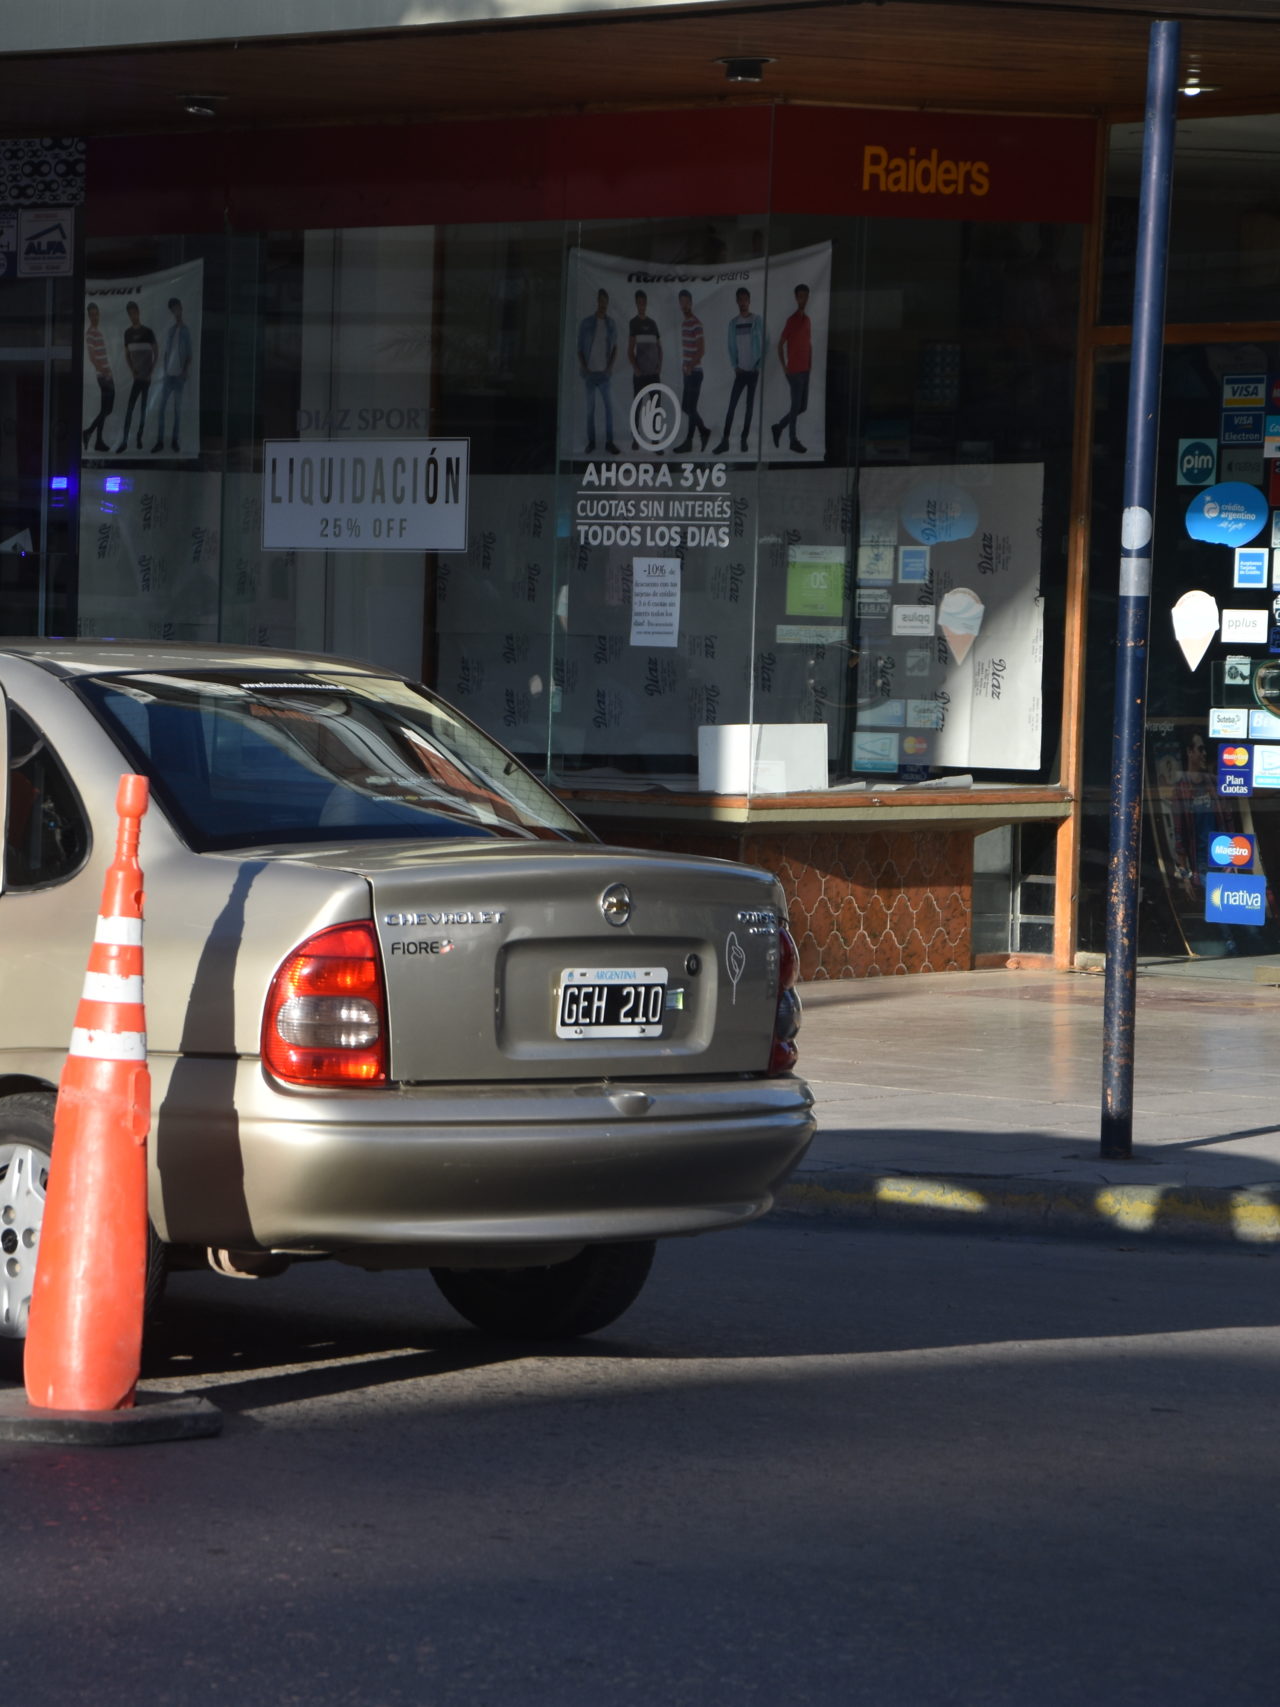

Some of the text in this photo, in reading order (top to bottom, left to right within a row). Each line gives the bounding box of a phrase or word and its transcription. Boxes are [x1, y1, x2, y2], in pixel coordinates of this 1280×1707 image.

[863, 144, 991, 197] Raiders
[24, 241, 67, 255] ALFA
[1231, 385, 1259, 398] VISA
[296, 409, 352, 432] DIAZ
[1233, 415, 1253, 425] VISA
[1224, 431, 1260, 441] Electron
[1182, 449, 1213, 475] pim
[271, 447, 461, 505] LIQUIDACIÓN
[582, 462, 727, 492] AHORA 3y6
[576, 496, 732, 519] CUOTAS SIN INTERÉS
[1221, 502, 1246, 513] crédito
[1221, 510, 1256, 521] argentino
[320, 517, 408, 539] 25% OFF
[576, 524, 730, 549] TODOS LOS DIAS
[643, 563, 666, 577] -10%
[1228, 617, 1258, 629] pplus
[937, 636, 948, 665] iaz
[1225, 774, 1245, 785] Plan
[1221, 783, 1249, 794] Cuotas
[1215, 844, 1249, 857] Maestro
[1223, 889, 1261, 907] nativa
[383, 911, 507, 926] CHEVROLET
[391, 940, 439, 955] FIORE
[594, 969, 637, 981] ARGENTINA
[564, 985, 663, 1024] GEH 210
